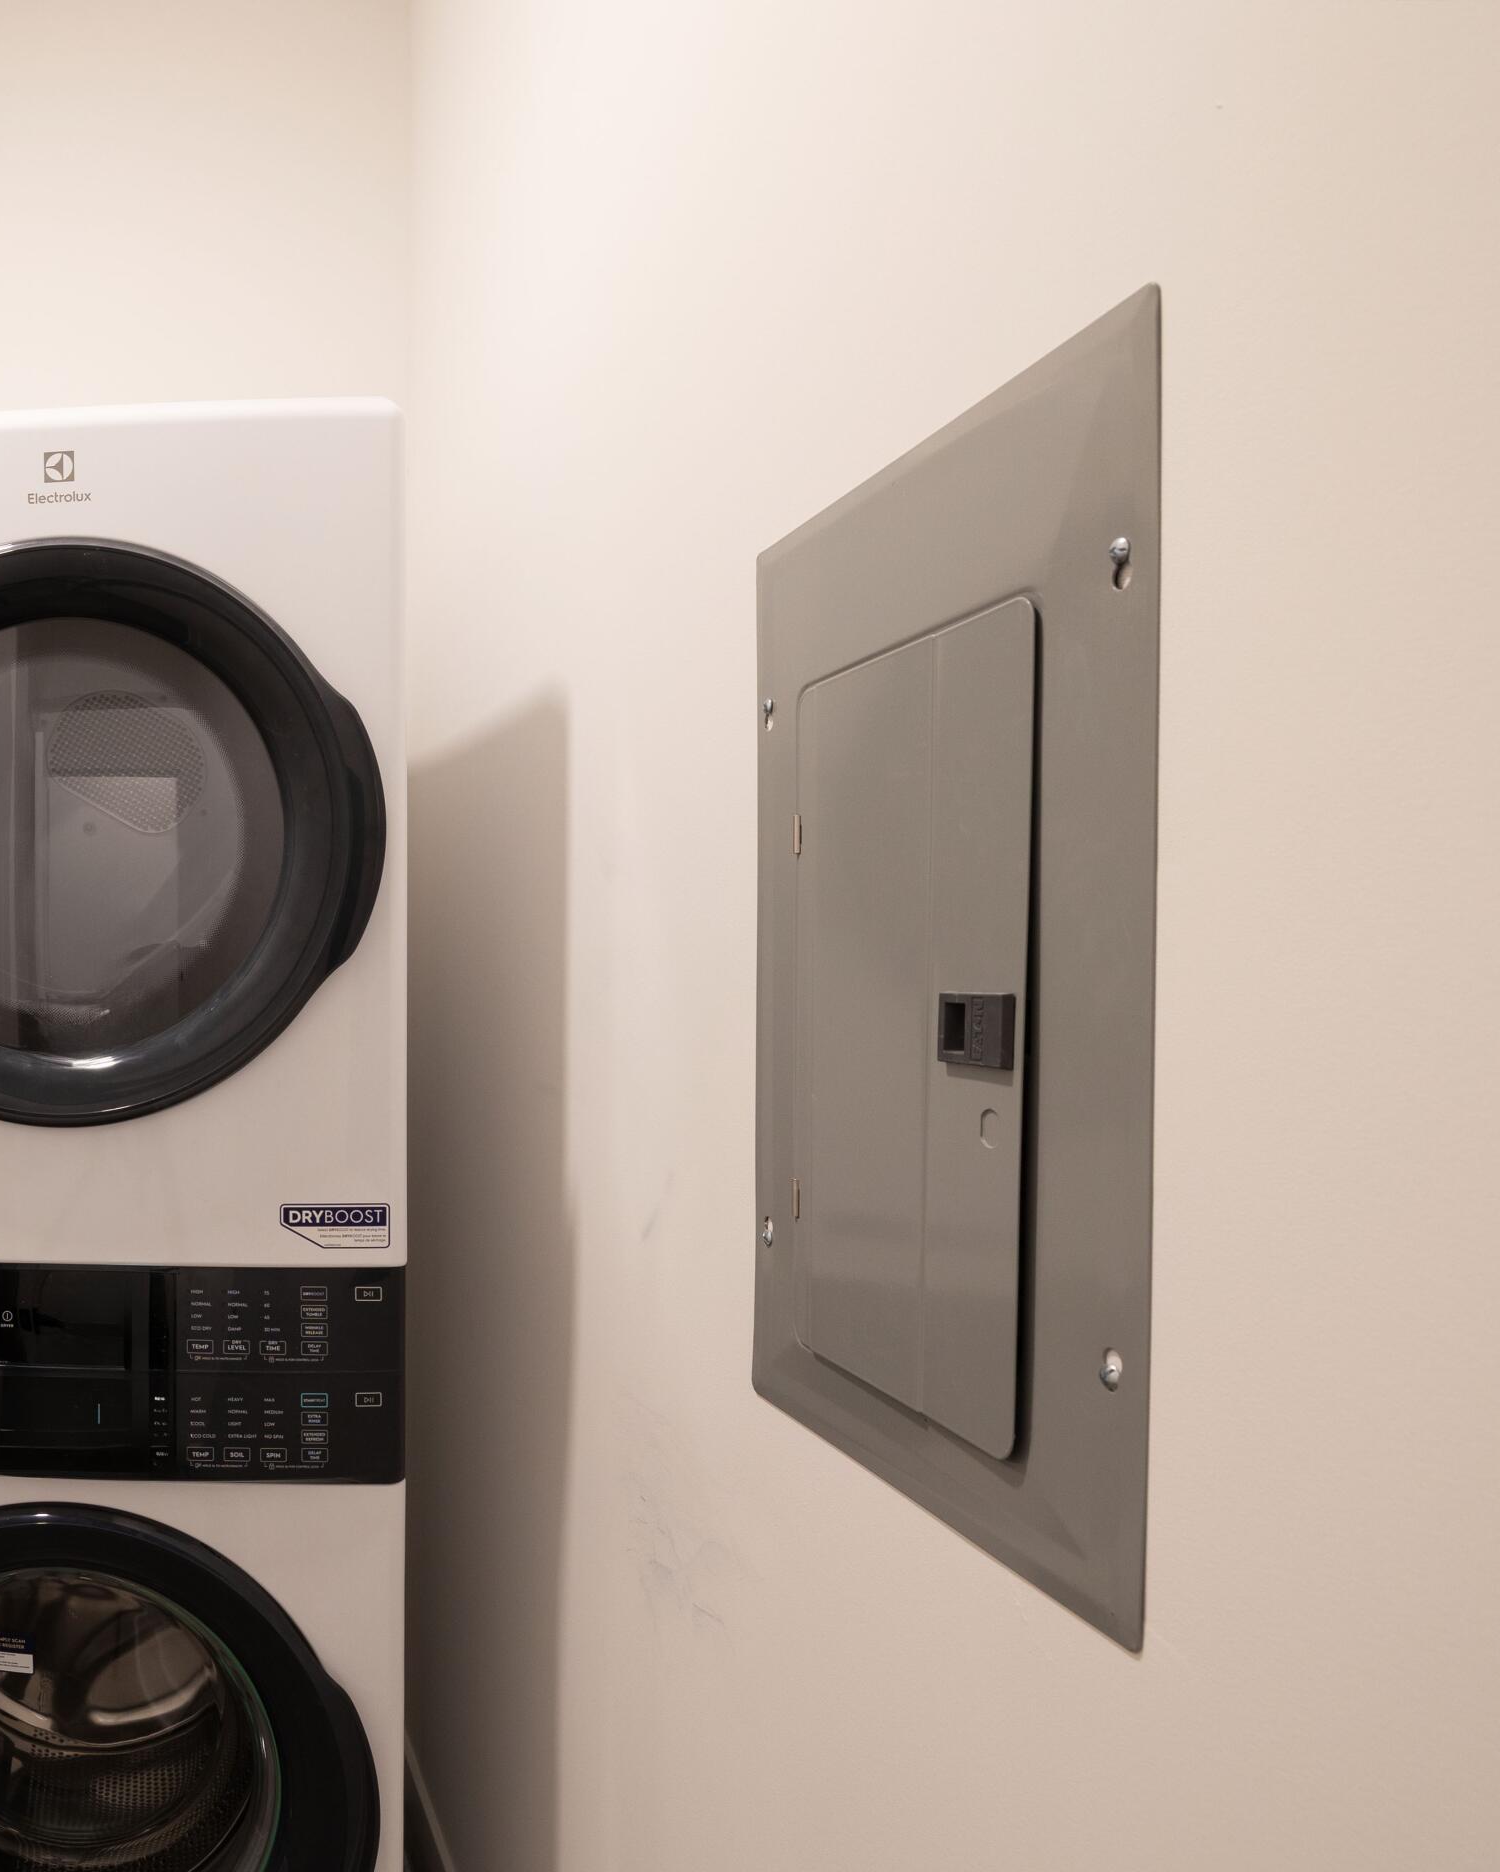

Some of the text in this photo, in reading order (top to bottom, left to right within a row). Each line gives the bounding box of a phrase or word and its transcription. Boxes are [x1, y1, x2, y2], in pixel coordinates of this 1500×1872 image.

[28, 492, 92, 504] Electrolux
[289, 1210, 383, 1224] DRYBOOST
[192, 1451, 209, 1459] TEMP
